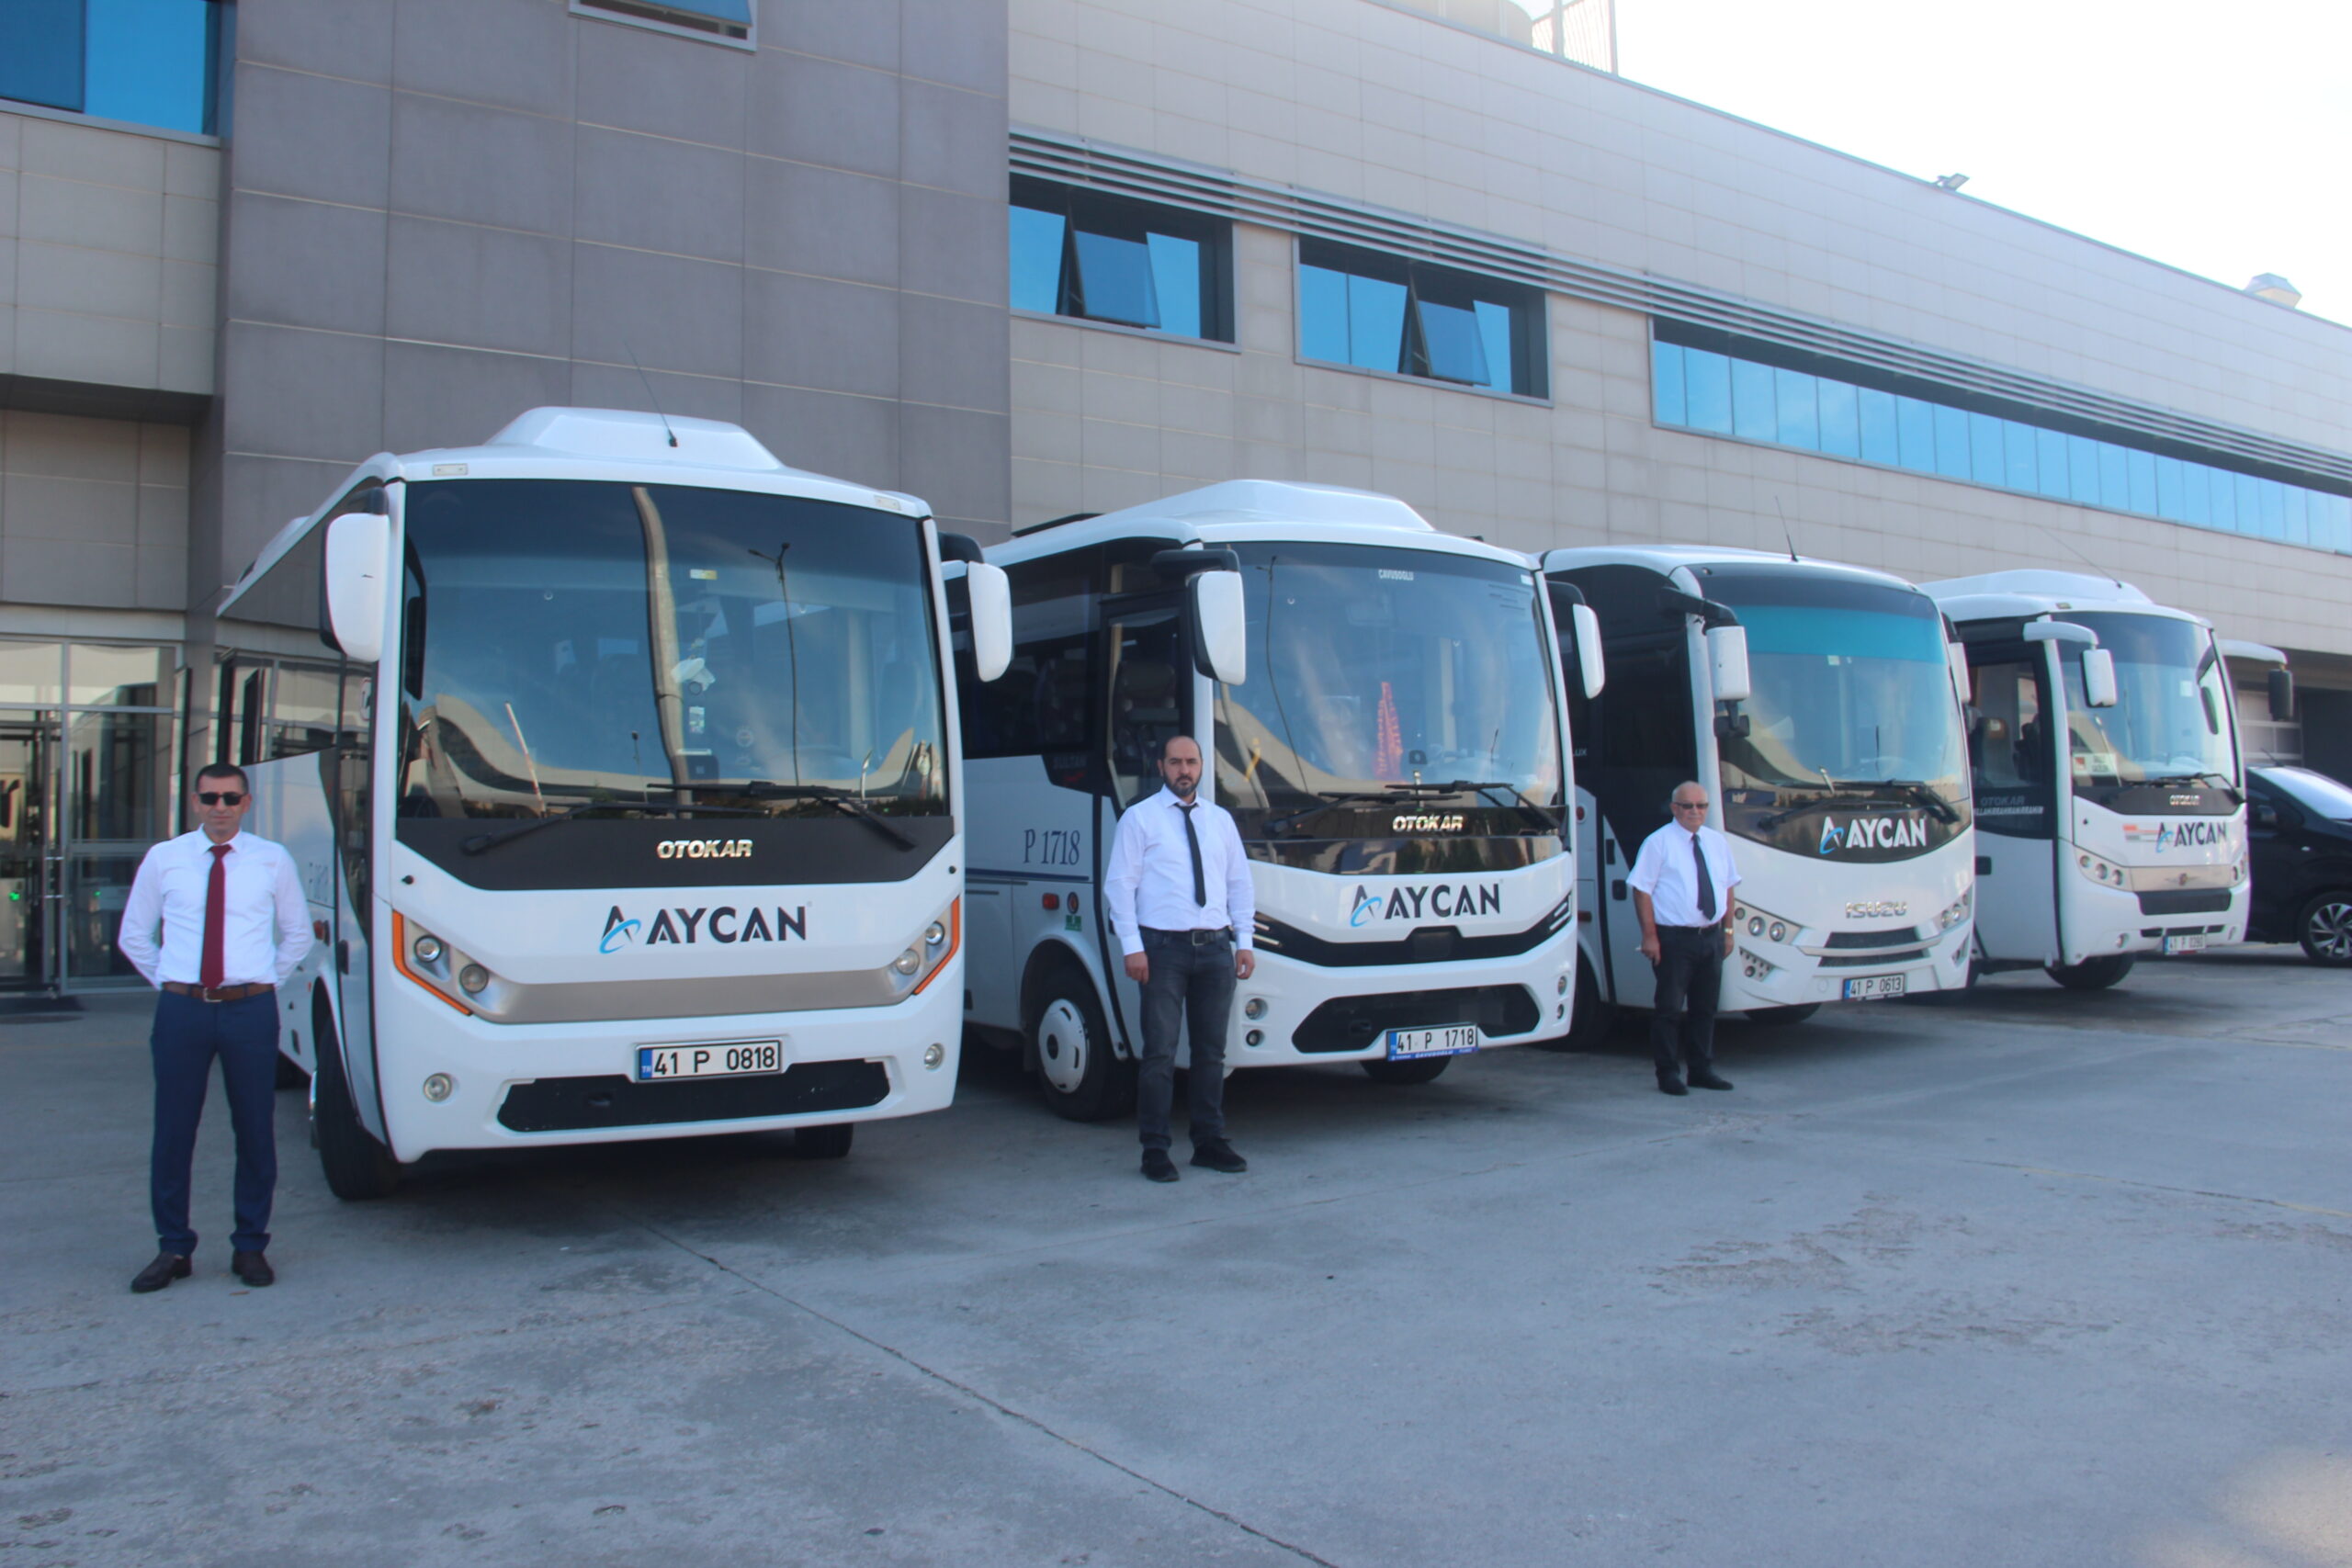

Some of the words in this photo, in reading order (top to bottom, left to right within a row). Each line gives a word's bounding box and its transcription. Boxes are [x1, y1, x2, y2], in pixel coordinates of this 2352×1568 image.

[1392, 815, 1464, 832] OTOKAR
[1845, 817, 1927, 849] AYCAN
[2174, 821, 2227, 847] AYCAN
[656, 840, 753, 859] OTOKAR
[1023, 829, 1036, 864] P
[1041, 829, 1080, 866] 1718
[1384, 883, 1500, 919] AYCAN
[1846, 901, 1907, 919] ISUZU
[646, 906, 807, 945] AYCAN
[1850, 980, 1860, 995] 41
[1866, 979, 1874, 993] P
[1880, 976, 1902, 993] 0613
[1397, 1033, 1411, 1052] 41
[1425, 1032, 1432, 1049] P
[1445, 1028, 1475, 1047] 1718
[654, 1052, 678, 1076] 41
[695, 1050, 710, 1073] P
[727, 1045, 775, 1071] 0818
